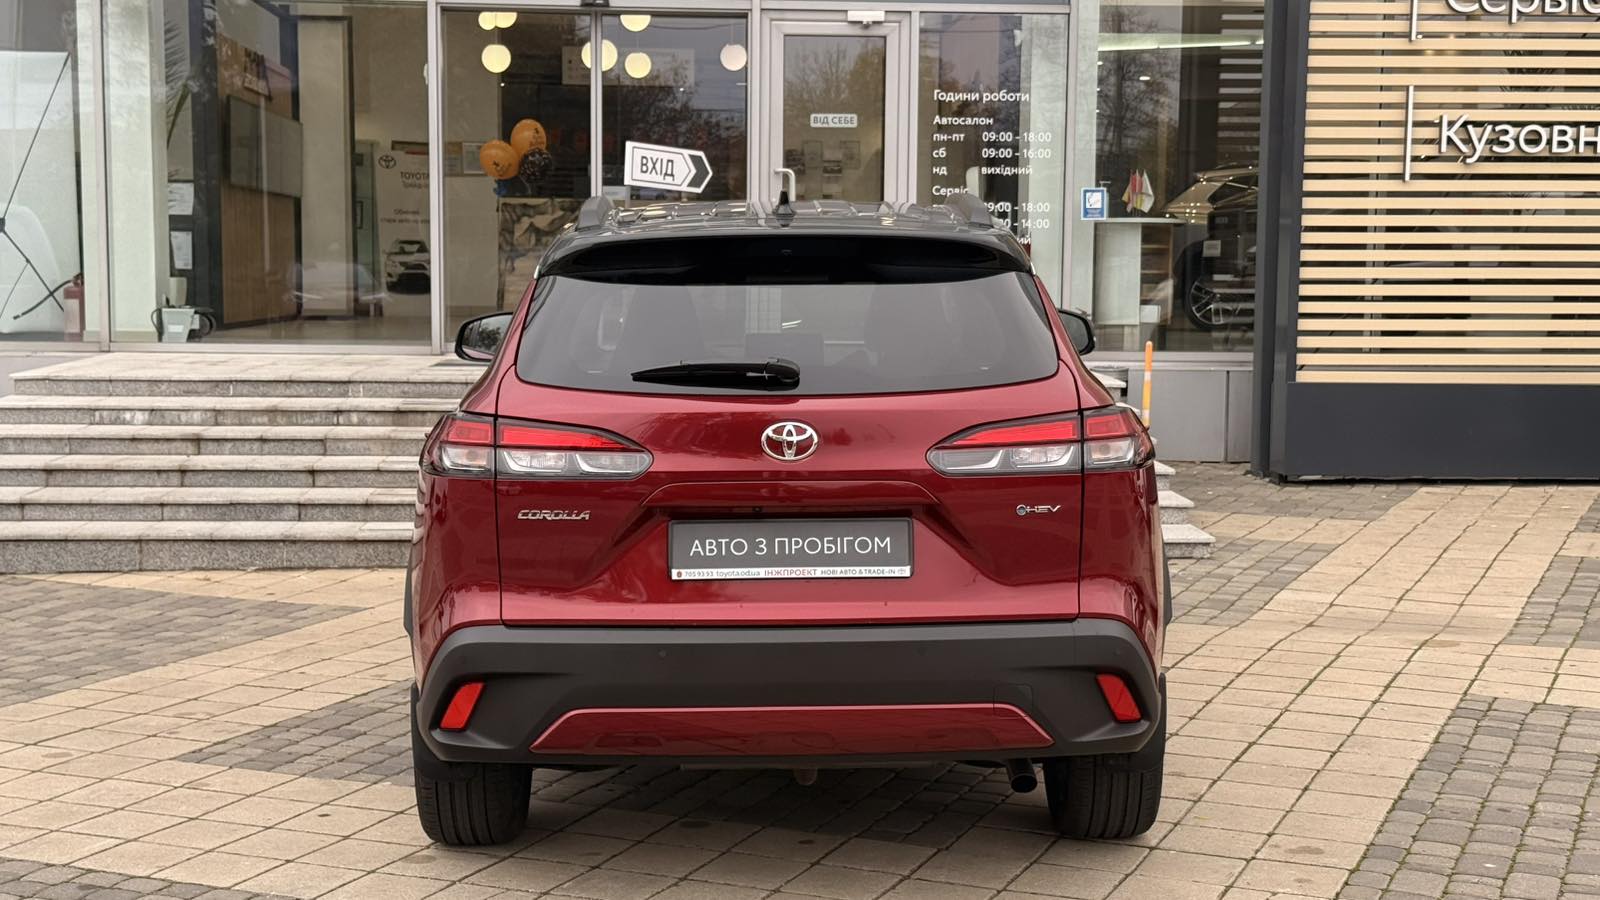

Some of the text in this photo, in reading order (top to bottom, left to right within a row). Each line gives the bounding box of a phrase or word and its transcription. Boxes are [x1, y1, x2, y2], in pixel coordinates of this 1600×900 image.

[933, 90, 1030, 103] Години роботи
[813, 116, 855, 126] ВІД СЕБЕ
[933, 115, 994, 125] Автосалон
[933, 133, 965, 142] пн-пт
[982, 132, 1012, 142] 09:00
[1023, 132, 1052, 142] 18:00
[1440, 114, 1600, 164] Кузовн
[932, 148, 946, 158] сб
[982, 148, 1012, 158] 09:00
[1023, 148, 1051, 158] 16:00
[640, 155, 675, 182] ВХІД
[932, 165, 1033, 176] нд вихідний
[1022, 202, 1050, 212] 18:00
[1022, 219, 1050, 229] 14:00
[517, 509, 591, 520] COROLLA
[689, 538, 748, 556] АВТО
[775, 536, 891, 555] ПРОБІГОМ
[764, 569, 817, 577] ІНЖПРОЕКТ
